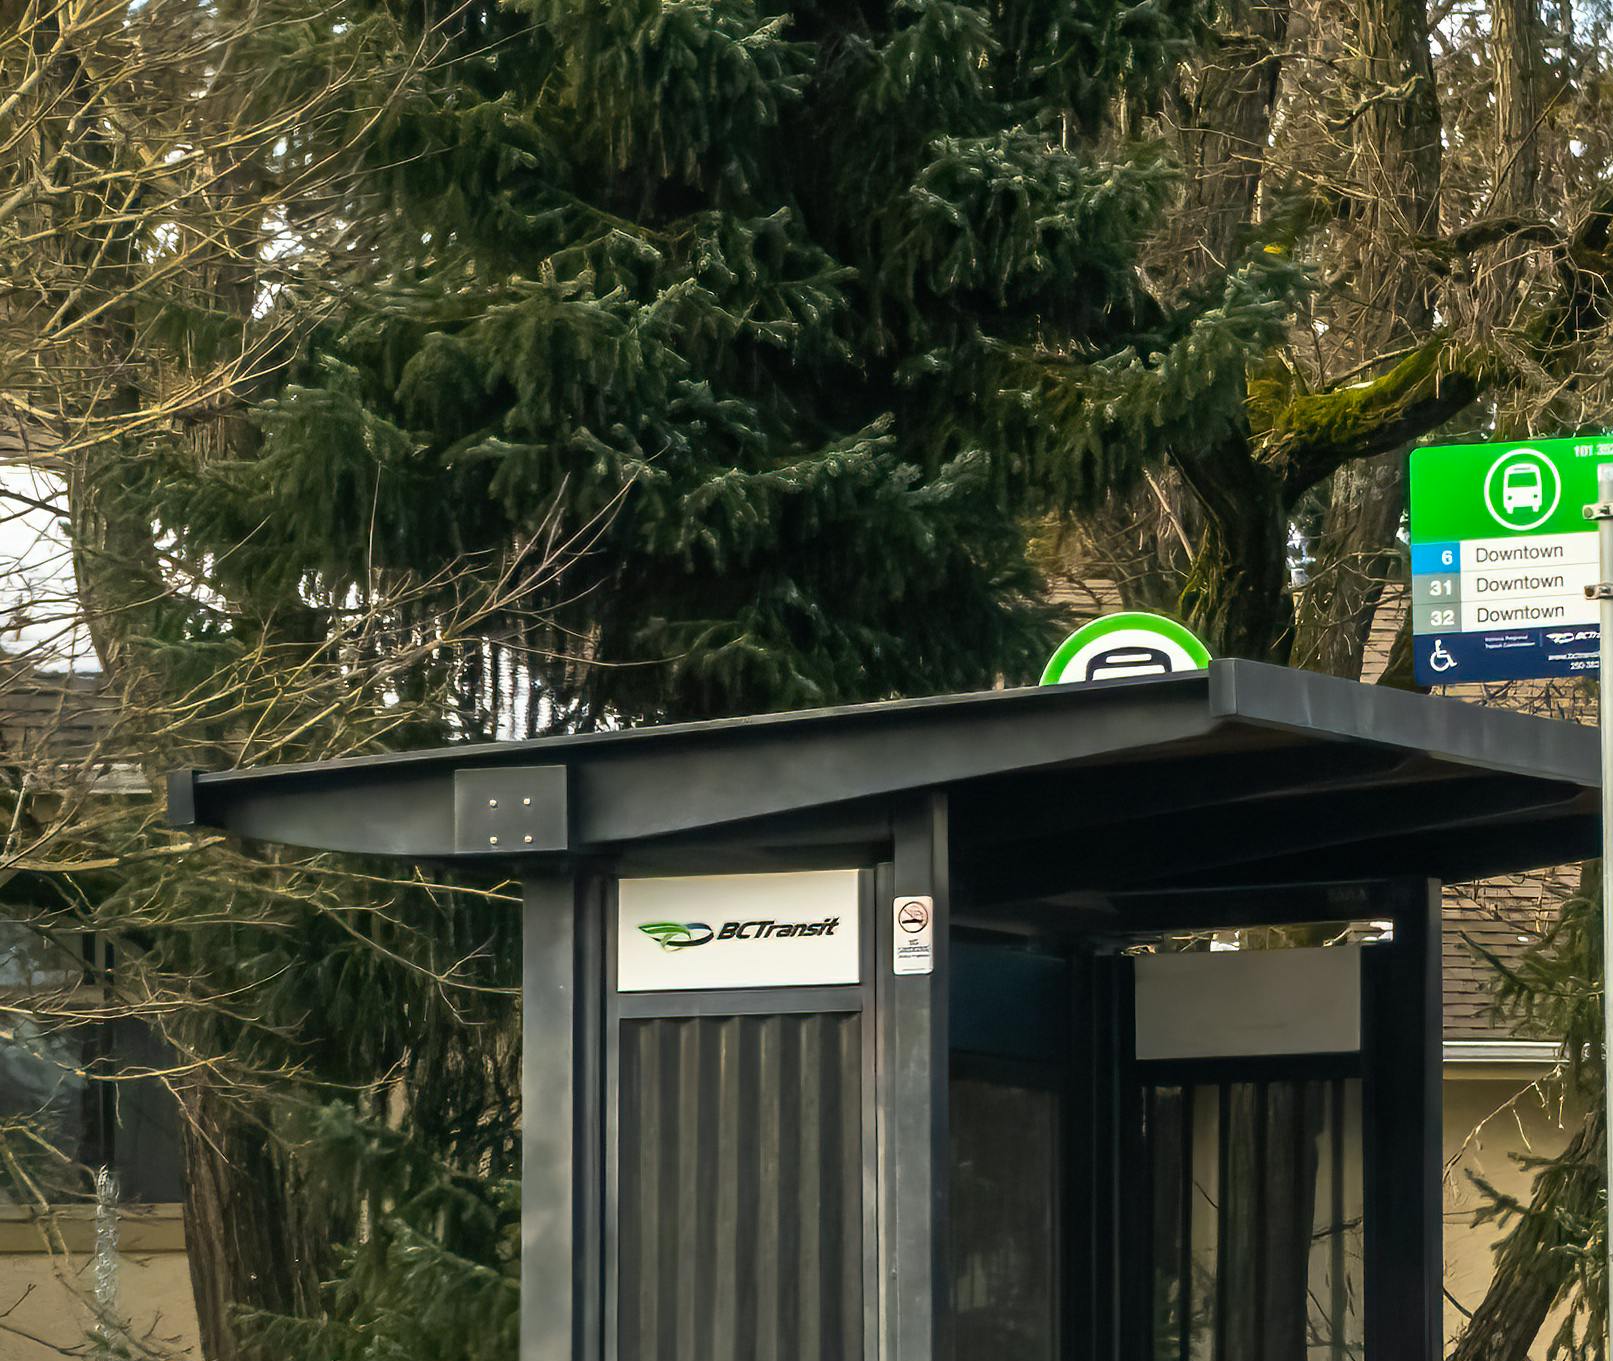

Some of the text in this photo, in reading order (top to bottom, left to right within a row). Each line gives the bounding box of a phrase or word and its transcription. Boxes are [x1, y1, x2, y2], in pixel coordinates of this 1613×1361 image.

[1441, 545, 1564, 566] 6 Downtown
[1429, 574, 1564, 596] 31 Downtown
[1430, 605, 1565, 627] 32 Downtown
[716, 916, 841, 941] BCTransit
